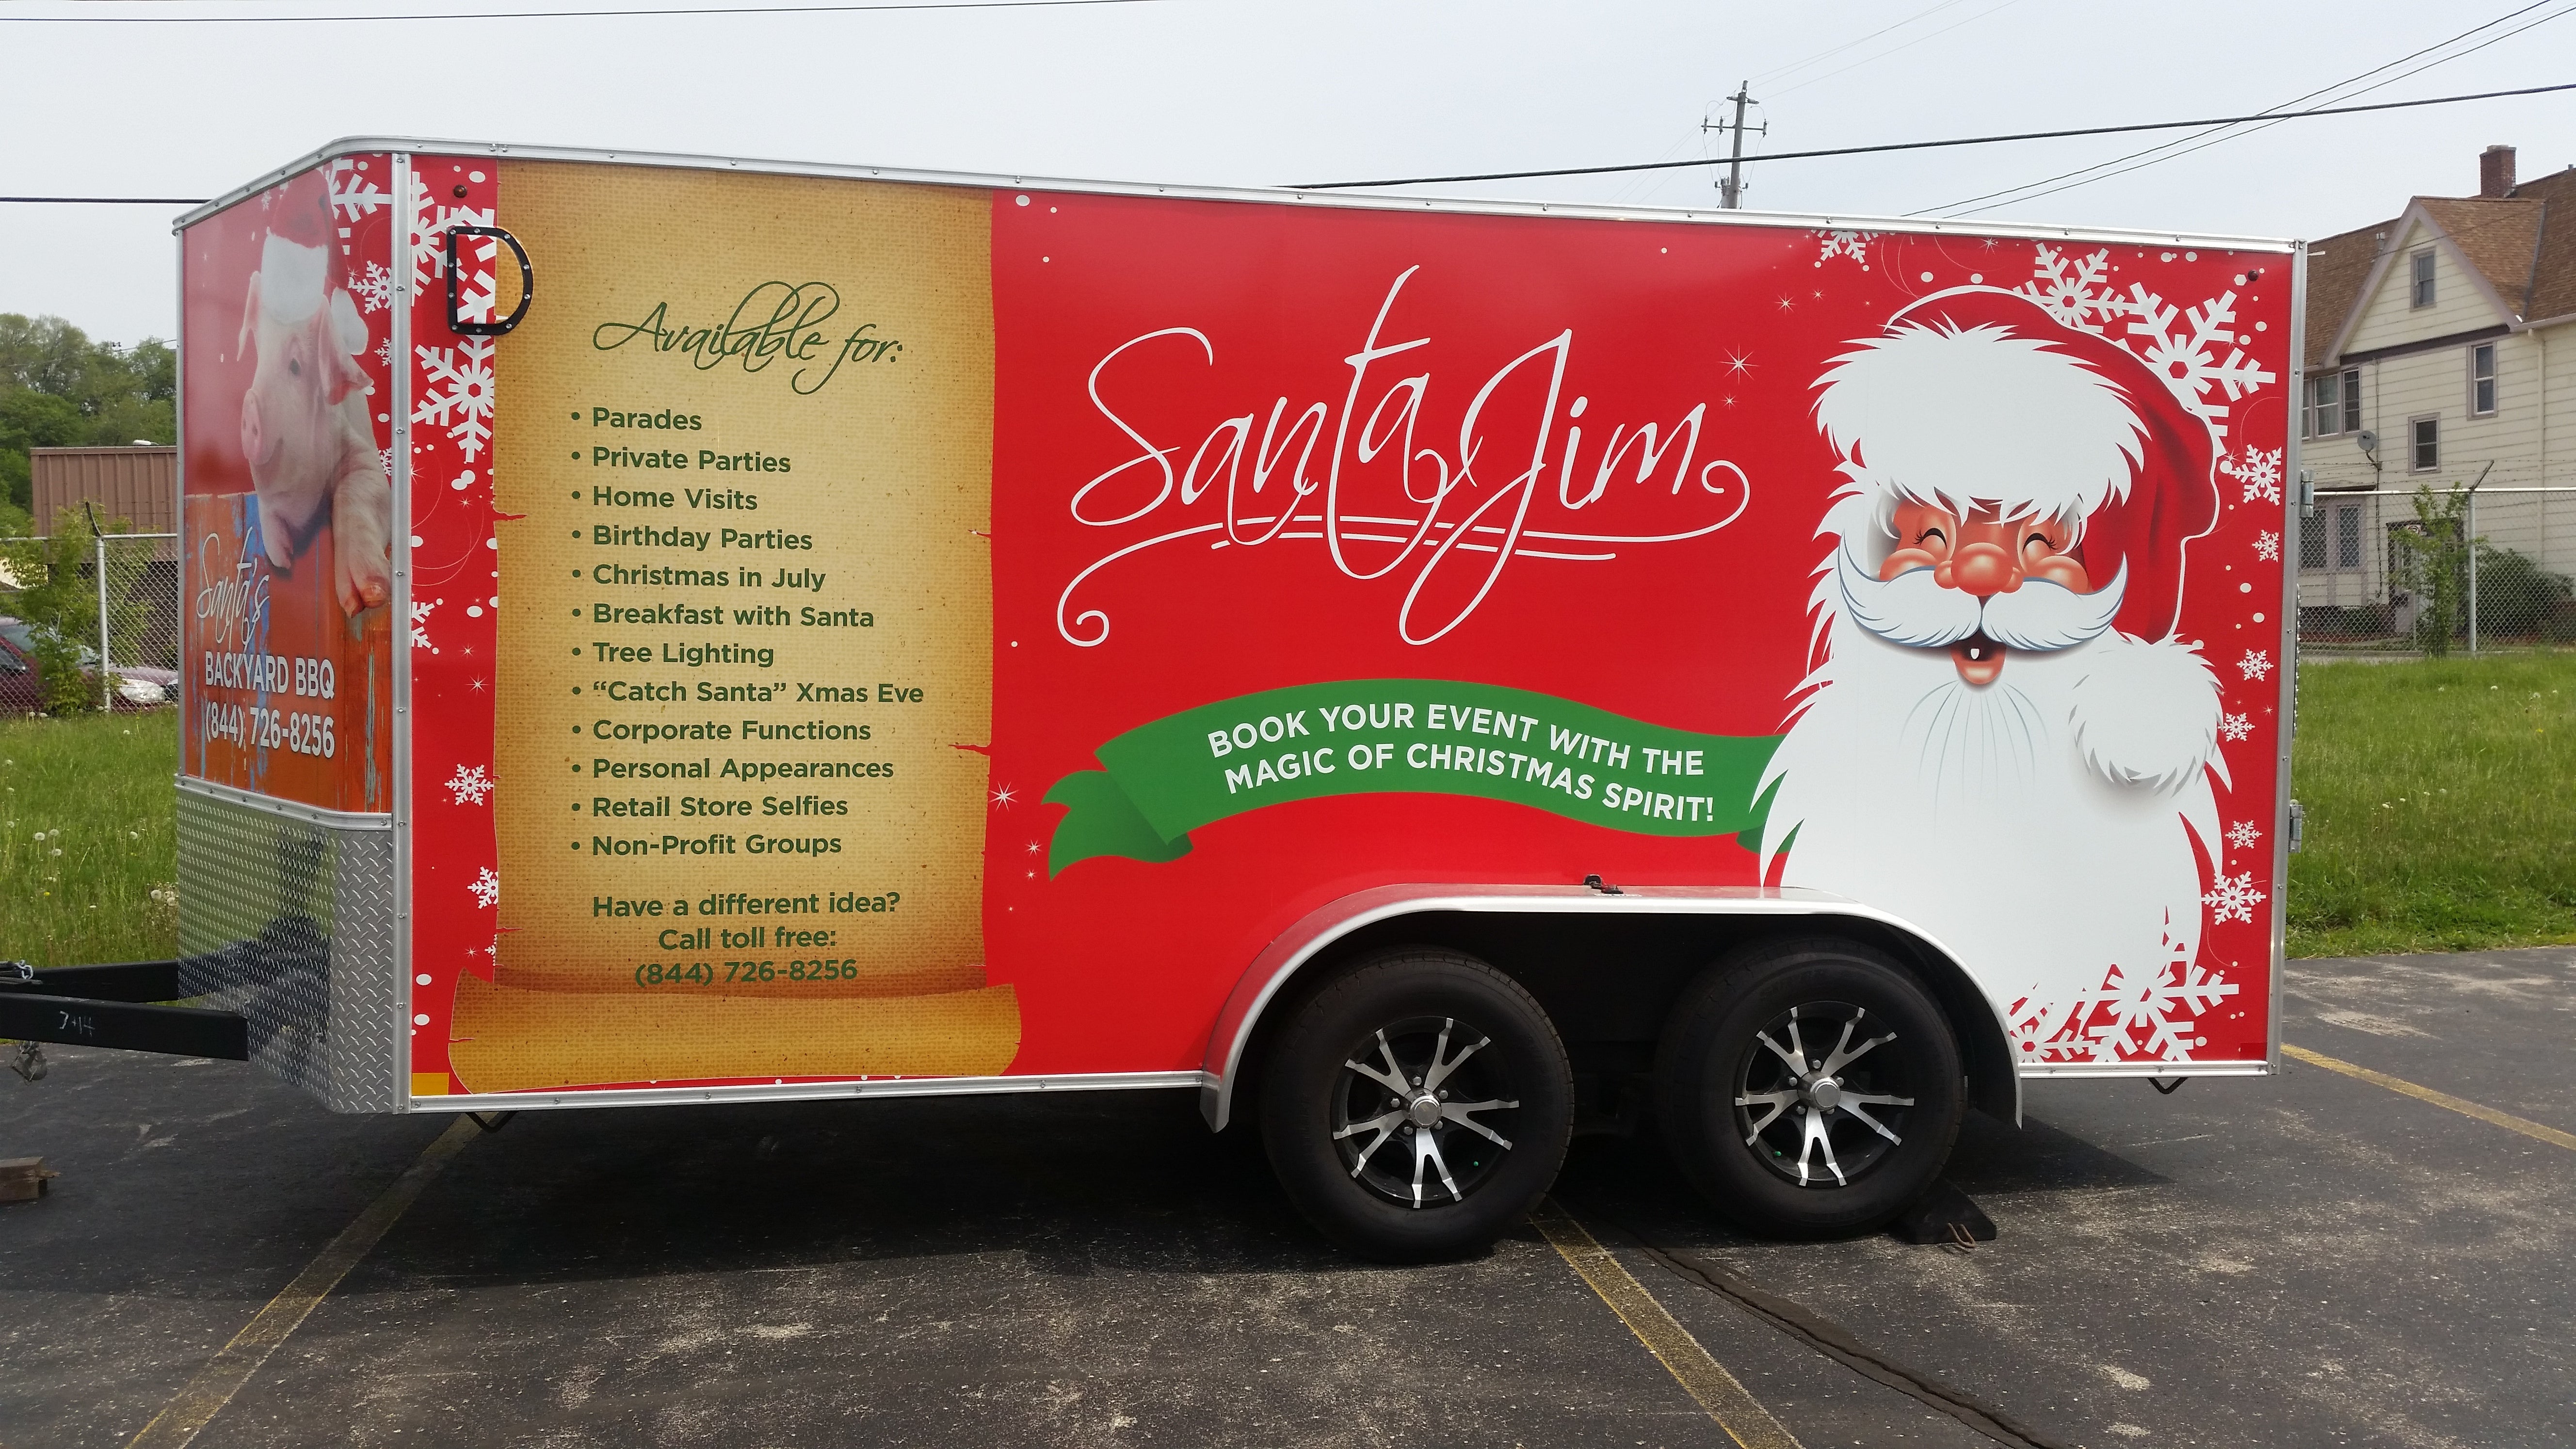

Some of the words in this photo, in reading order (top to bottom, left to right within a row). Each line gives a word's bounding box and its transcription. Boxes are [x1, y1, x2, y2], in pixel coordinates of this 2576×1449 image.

[593, 281, 840, 372] Available
[792, 323, 902, 395] for:
[592, 406, 702, 431] Parades
[593, 446, 688, 469] Private
[698, 449, 791, 473] Parties
[1071, 265, 1450, 580] Santa
[1399, 328, 1719, 645] Jim
[593, 485, 675, 508] Home
[685, 488, 757, 510] Visits
[593, 525, 711, 551] Birthday
[721, 528, 813, 550] Parties
[196, 526, 270, 652] Santa's
[593, 564, 729, 587] Christmas
[739, 565, 762, 587] in
[772, 567, 825, 593] July
[593, 603, 723, 625] Breakfast
[733, 605, 790, 626] with
[800, 606, 874, 628] Santa
[593, 642, 652, 663] Tree
[662, 642, 774, 668] Lighting
[205, 651, 290, 694] BACKYARD
[295, 657, 335, 699] BBQ
[593, 681, 687, 702] “Catch
[696, 681, 786, 702] Santa”
[796, 683, 868, 703] Xmas
[878, 683, 923, 703] Eve
[205, 701, 244, 748] (844)
[250, 707, 335, 759] 726-8256
[593, 720, 731, 744] Corporate
[742, 720, 871, 741] Functions
[1207, 709, 1310, 758] BOOK
[1318, 703, 1415, 732] YOUR
[1427, 704, 1539, 743] EVENT
[1549, 724, 1631, 770] WITH
[1642, 747, 1704, 775] THE
[593, 757, 710, 779] Personal
[719, 757, 893, 782] Appearances
[1224, 747, 1336, 794] MAGIC
[1347, 743, 1394, 770] OF
[1406, 743, 1594, 800] CHRISTMAS
[1602, 784, 1714, 822] SPIRIT!
[593, 796, 670, 818] Retail
[680, 796, 752, 817] Store
[762, 795, 848, 817] Selfies
[592, 834, 735, 856] Non-Profit
[745, 834, 841, 857] Groups
[593, 896, 663, 917] Have
[673, 900, 689, 917] a
[698, 893, 819, 916] different
[829, 892, 900, 913] idea?
[659, 928, 710, 950] Call
[721, 927, 765, 949] toll
[775, 926, 835, 947] free:
[635, 963, 713, 987] (844)
[725, 959, 857, 982] 726-8256
